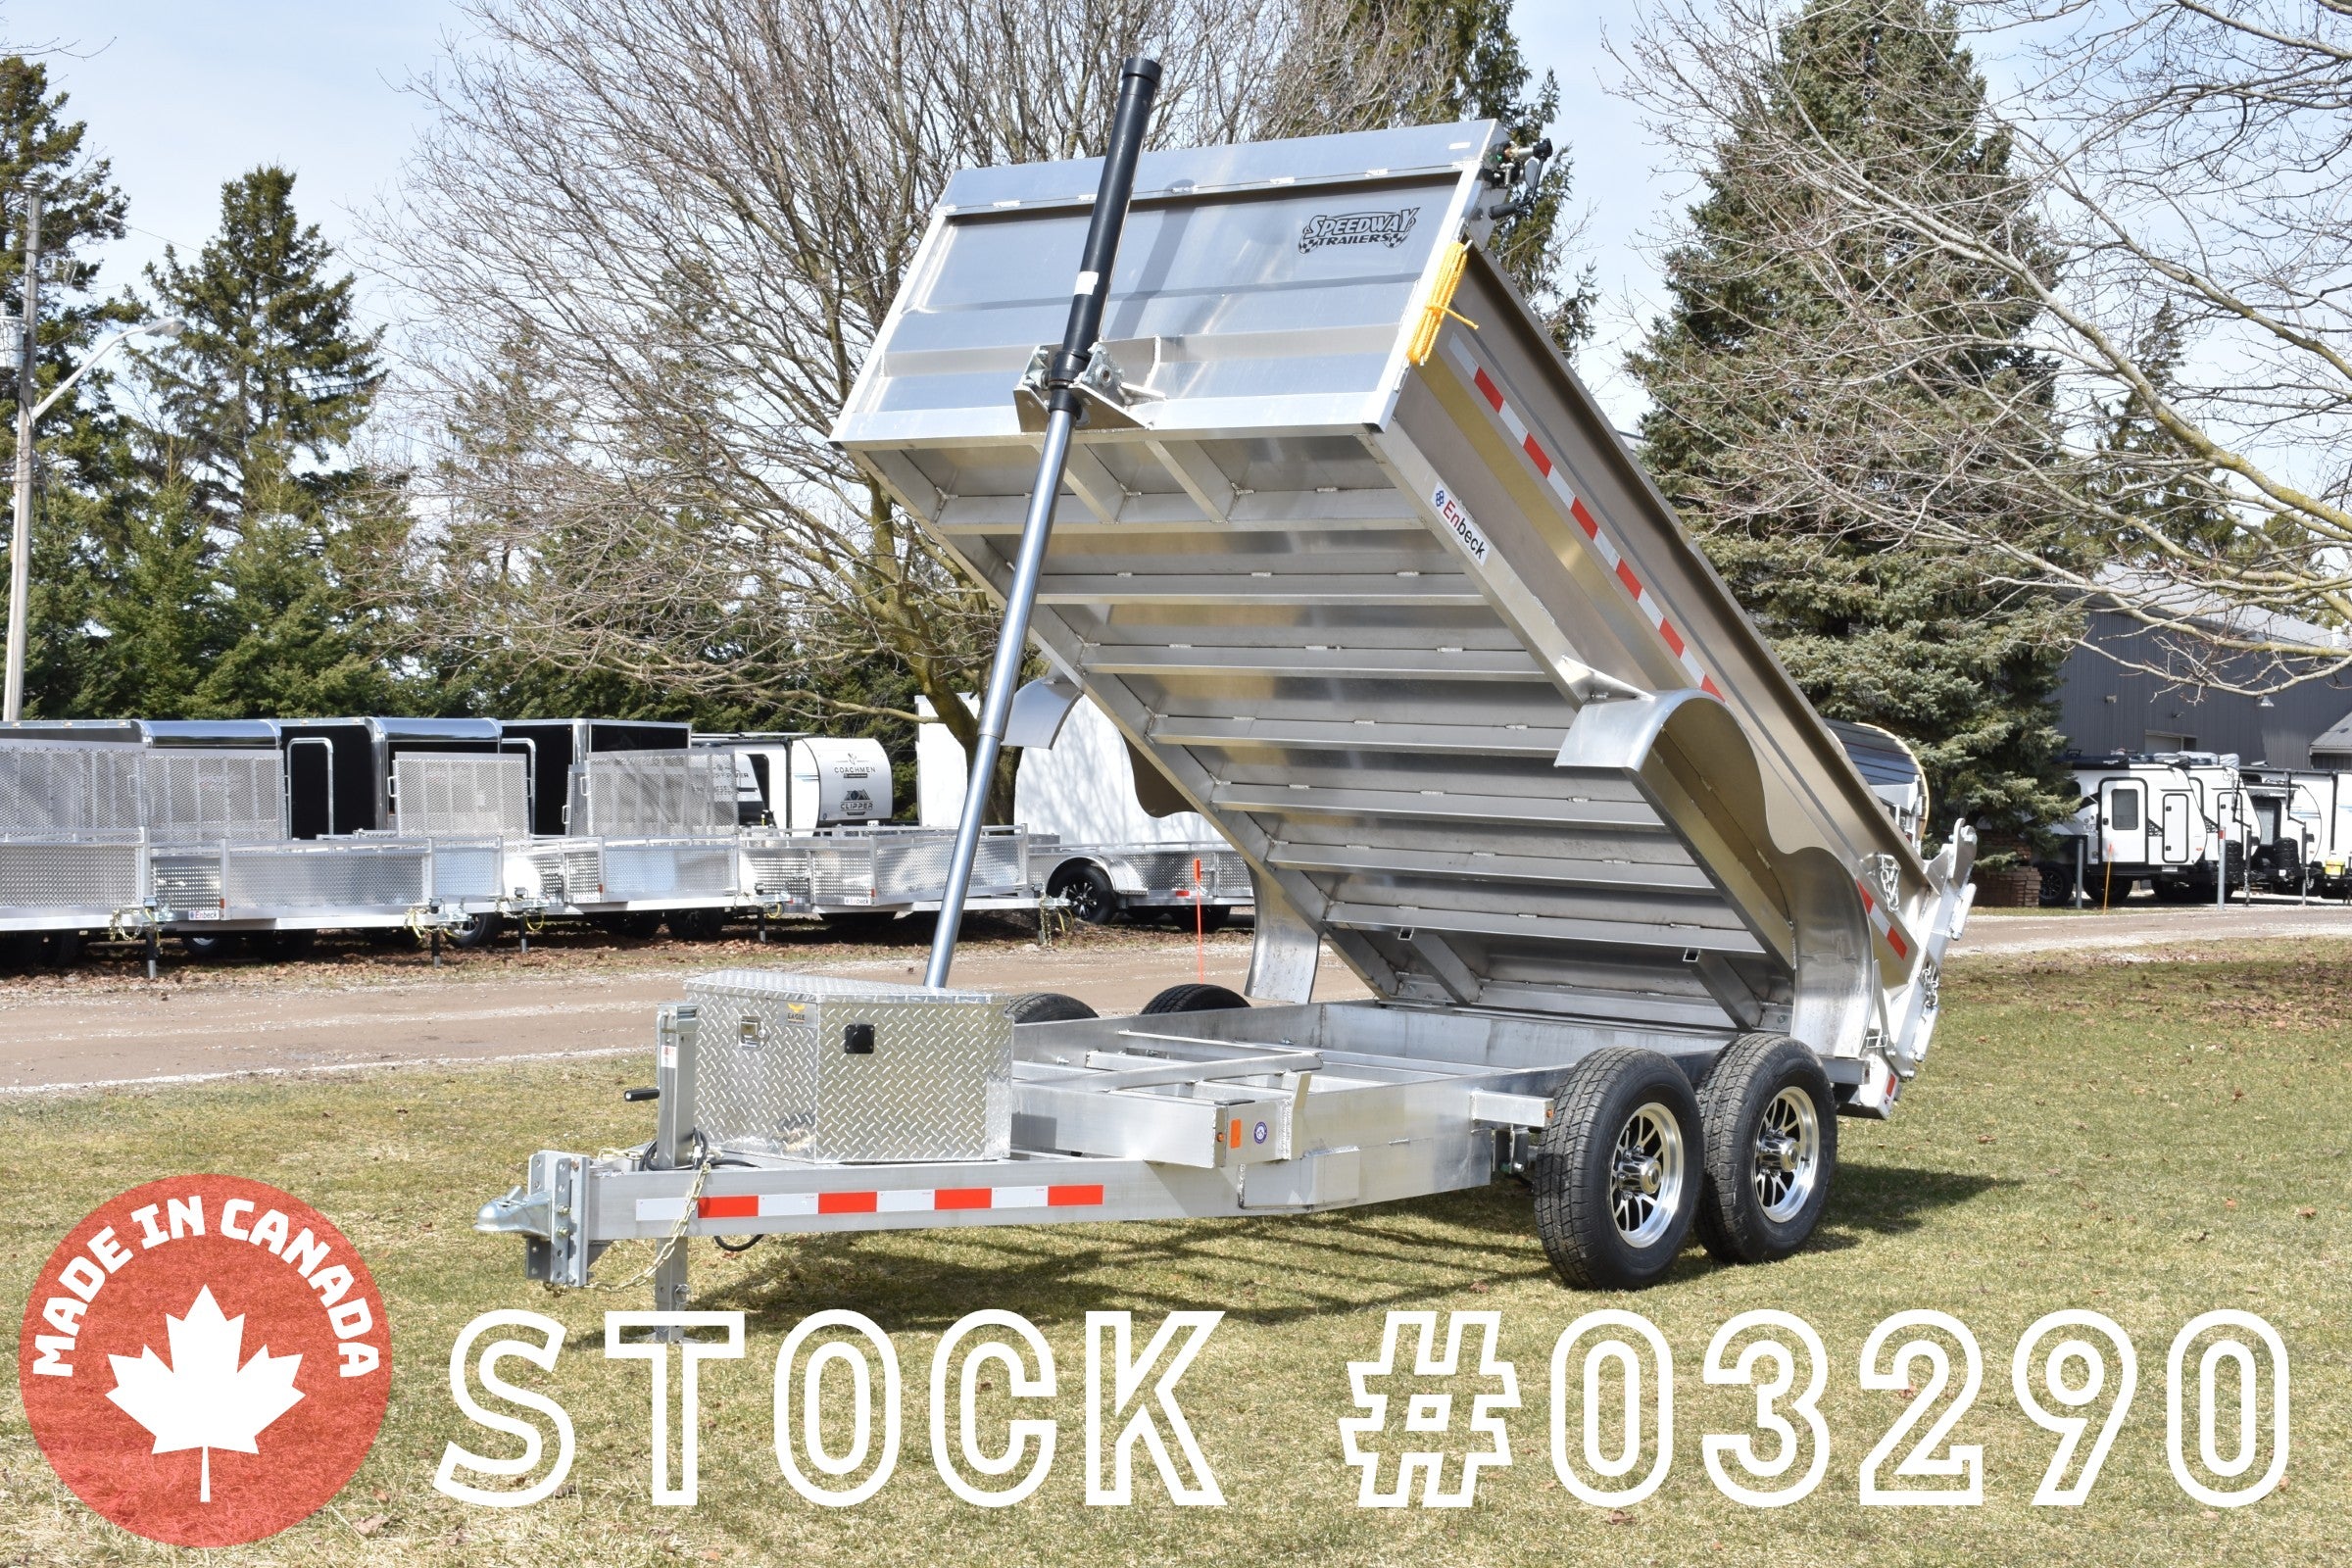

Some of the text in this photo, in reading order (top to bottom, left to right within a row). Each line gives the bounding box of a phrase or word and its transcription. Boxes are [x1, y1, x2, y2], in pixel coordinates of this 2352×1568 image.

[1303, 207, 1421, 239] SPEEDWAY
[1318, 232, 1392, 246] TRAILERS
[1443, 500, 1486, 560] Enbeck
